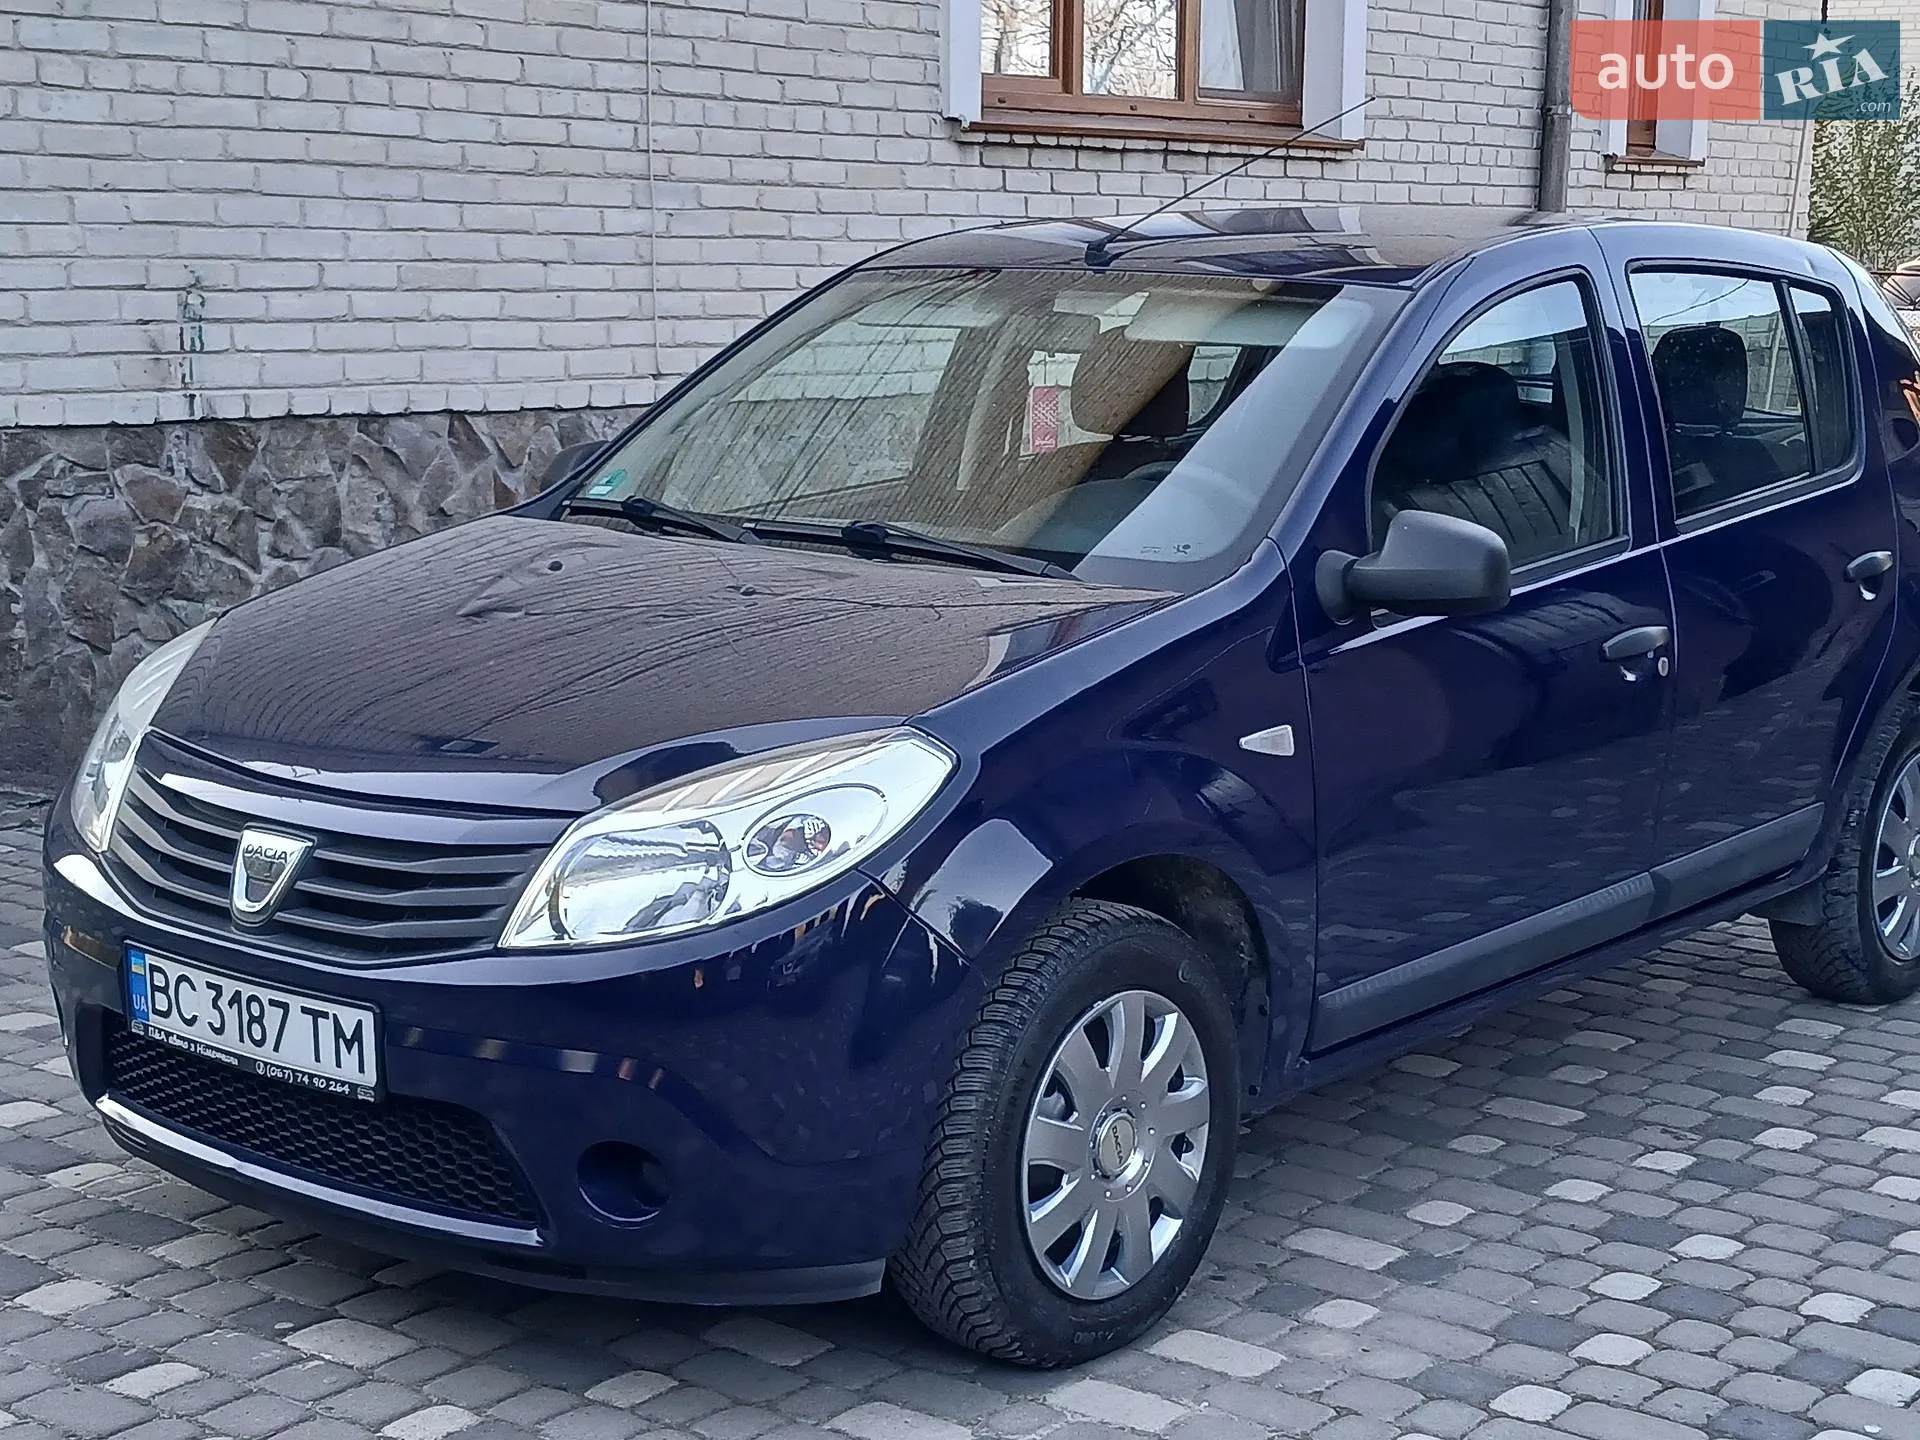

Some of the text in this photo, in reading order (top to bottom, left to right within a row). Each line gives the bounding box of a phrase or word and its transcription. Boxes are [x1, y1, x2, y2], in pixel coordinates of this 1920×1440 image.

[244, 843, 288, 864] DACIA
[132, 993, 148, 1013] UA
[148, 962, 366, 1077] BC 3187 TM
